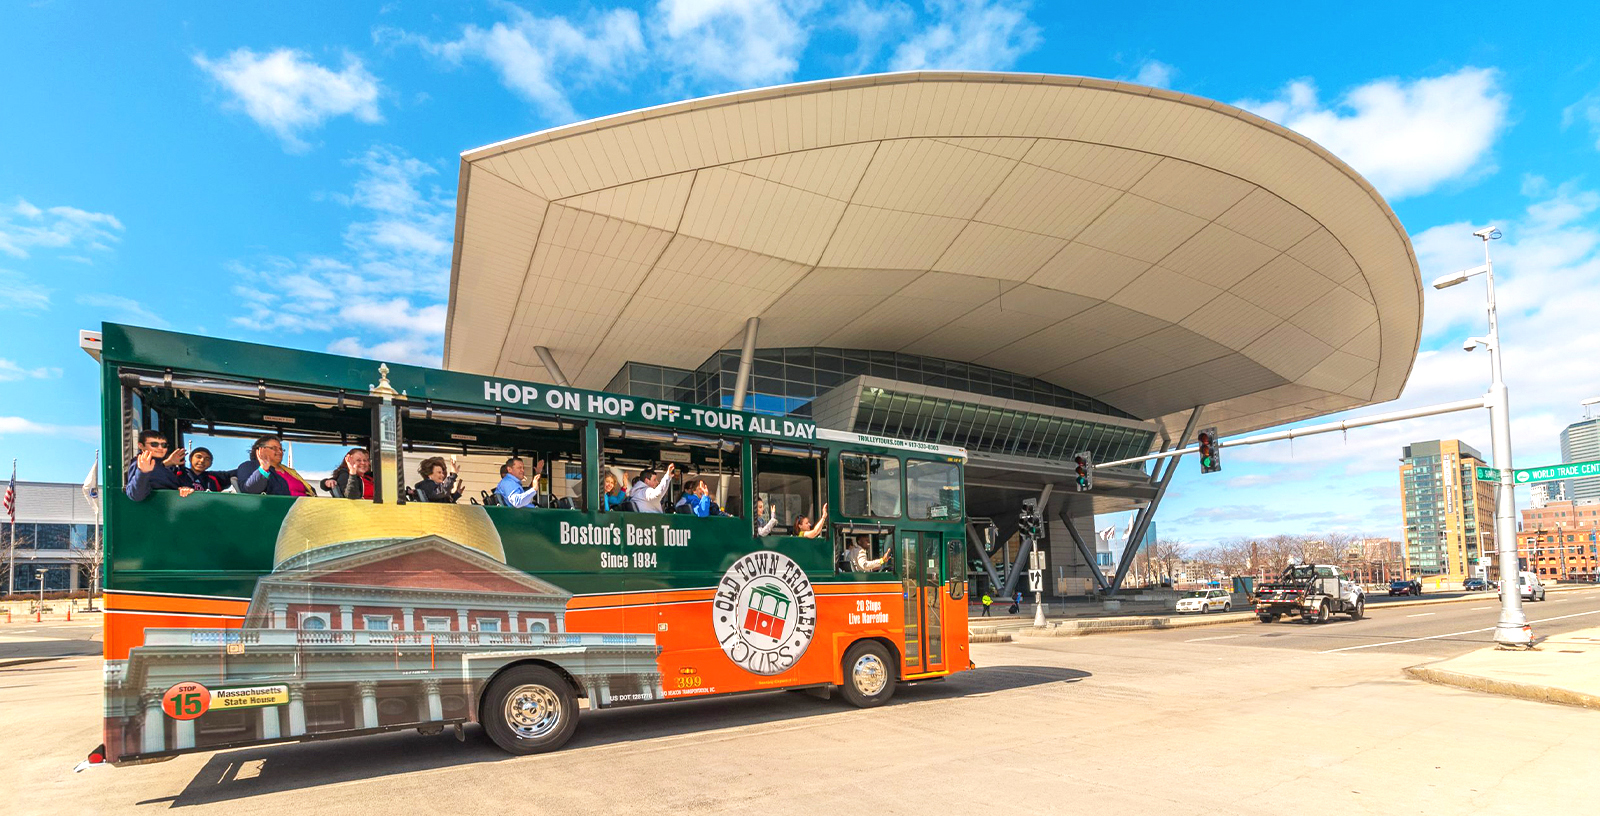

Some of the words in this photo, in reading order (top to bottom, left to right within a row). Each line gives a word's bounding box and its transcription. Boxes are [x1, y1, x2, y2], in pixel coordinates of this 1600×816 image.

[484, 381, 538, 405] HOP
[545, 390, 580, 411] ON
[588, 395, 634, 416] HOP
[641, 402, 680, 423] OFF
[748, 416, 781, 436] ALL
[783, 421, 816, 440] DAY
[1532, 469, 1555, 480] WORLD
[1557, 465, 1579, 476] TRADE
[1581, 463, 1600, 474] CENT
[560, 521, 621, 546] Boston's
[626, 523, 657, 546] Best
[661, 525, 691, 547] Tour
[600, 552, 629, 569] Since
[632, 552, 657, 568] 1984
[715, 575, 741, 612] OLD
[734, 553, 780, 582] TOWN
[782, 560, 815, 640] TROLLEY
[856, 600, 865, 611] 20
[865, 600, 881, 613] Stops
[848, 612, 861, 625] Live
[862, 611, 889, 624] Narration
[721, 624, 794, 674] TOURS
[677, 675, 702, 689] 399
[217, 686, 282, 698] Massachusetts
[609, 694, 619, 702] US
[619, 693, 631, 701] DOT
[170, 692, 202, 716] 15
[224, 698, 248, 706] State
[250, 696, 276, 704] House
